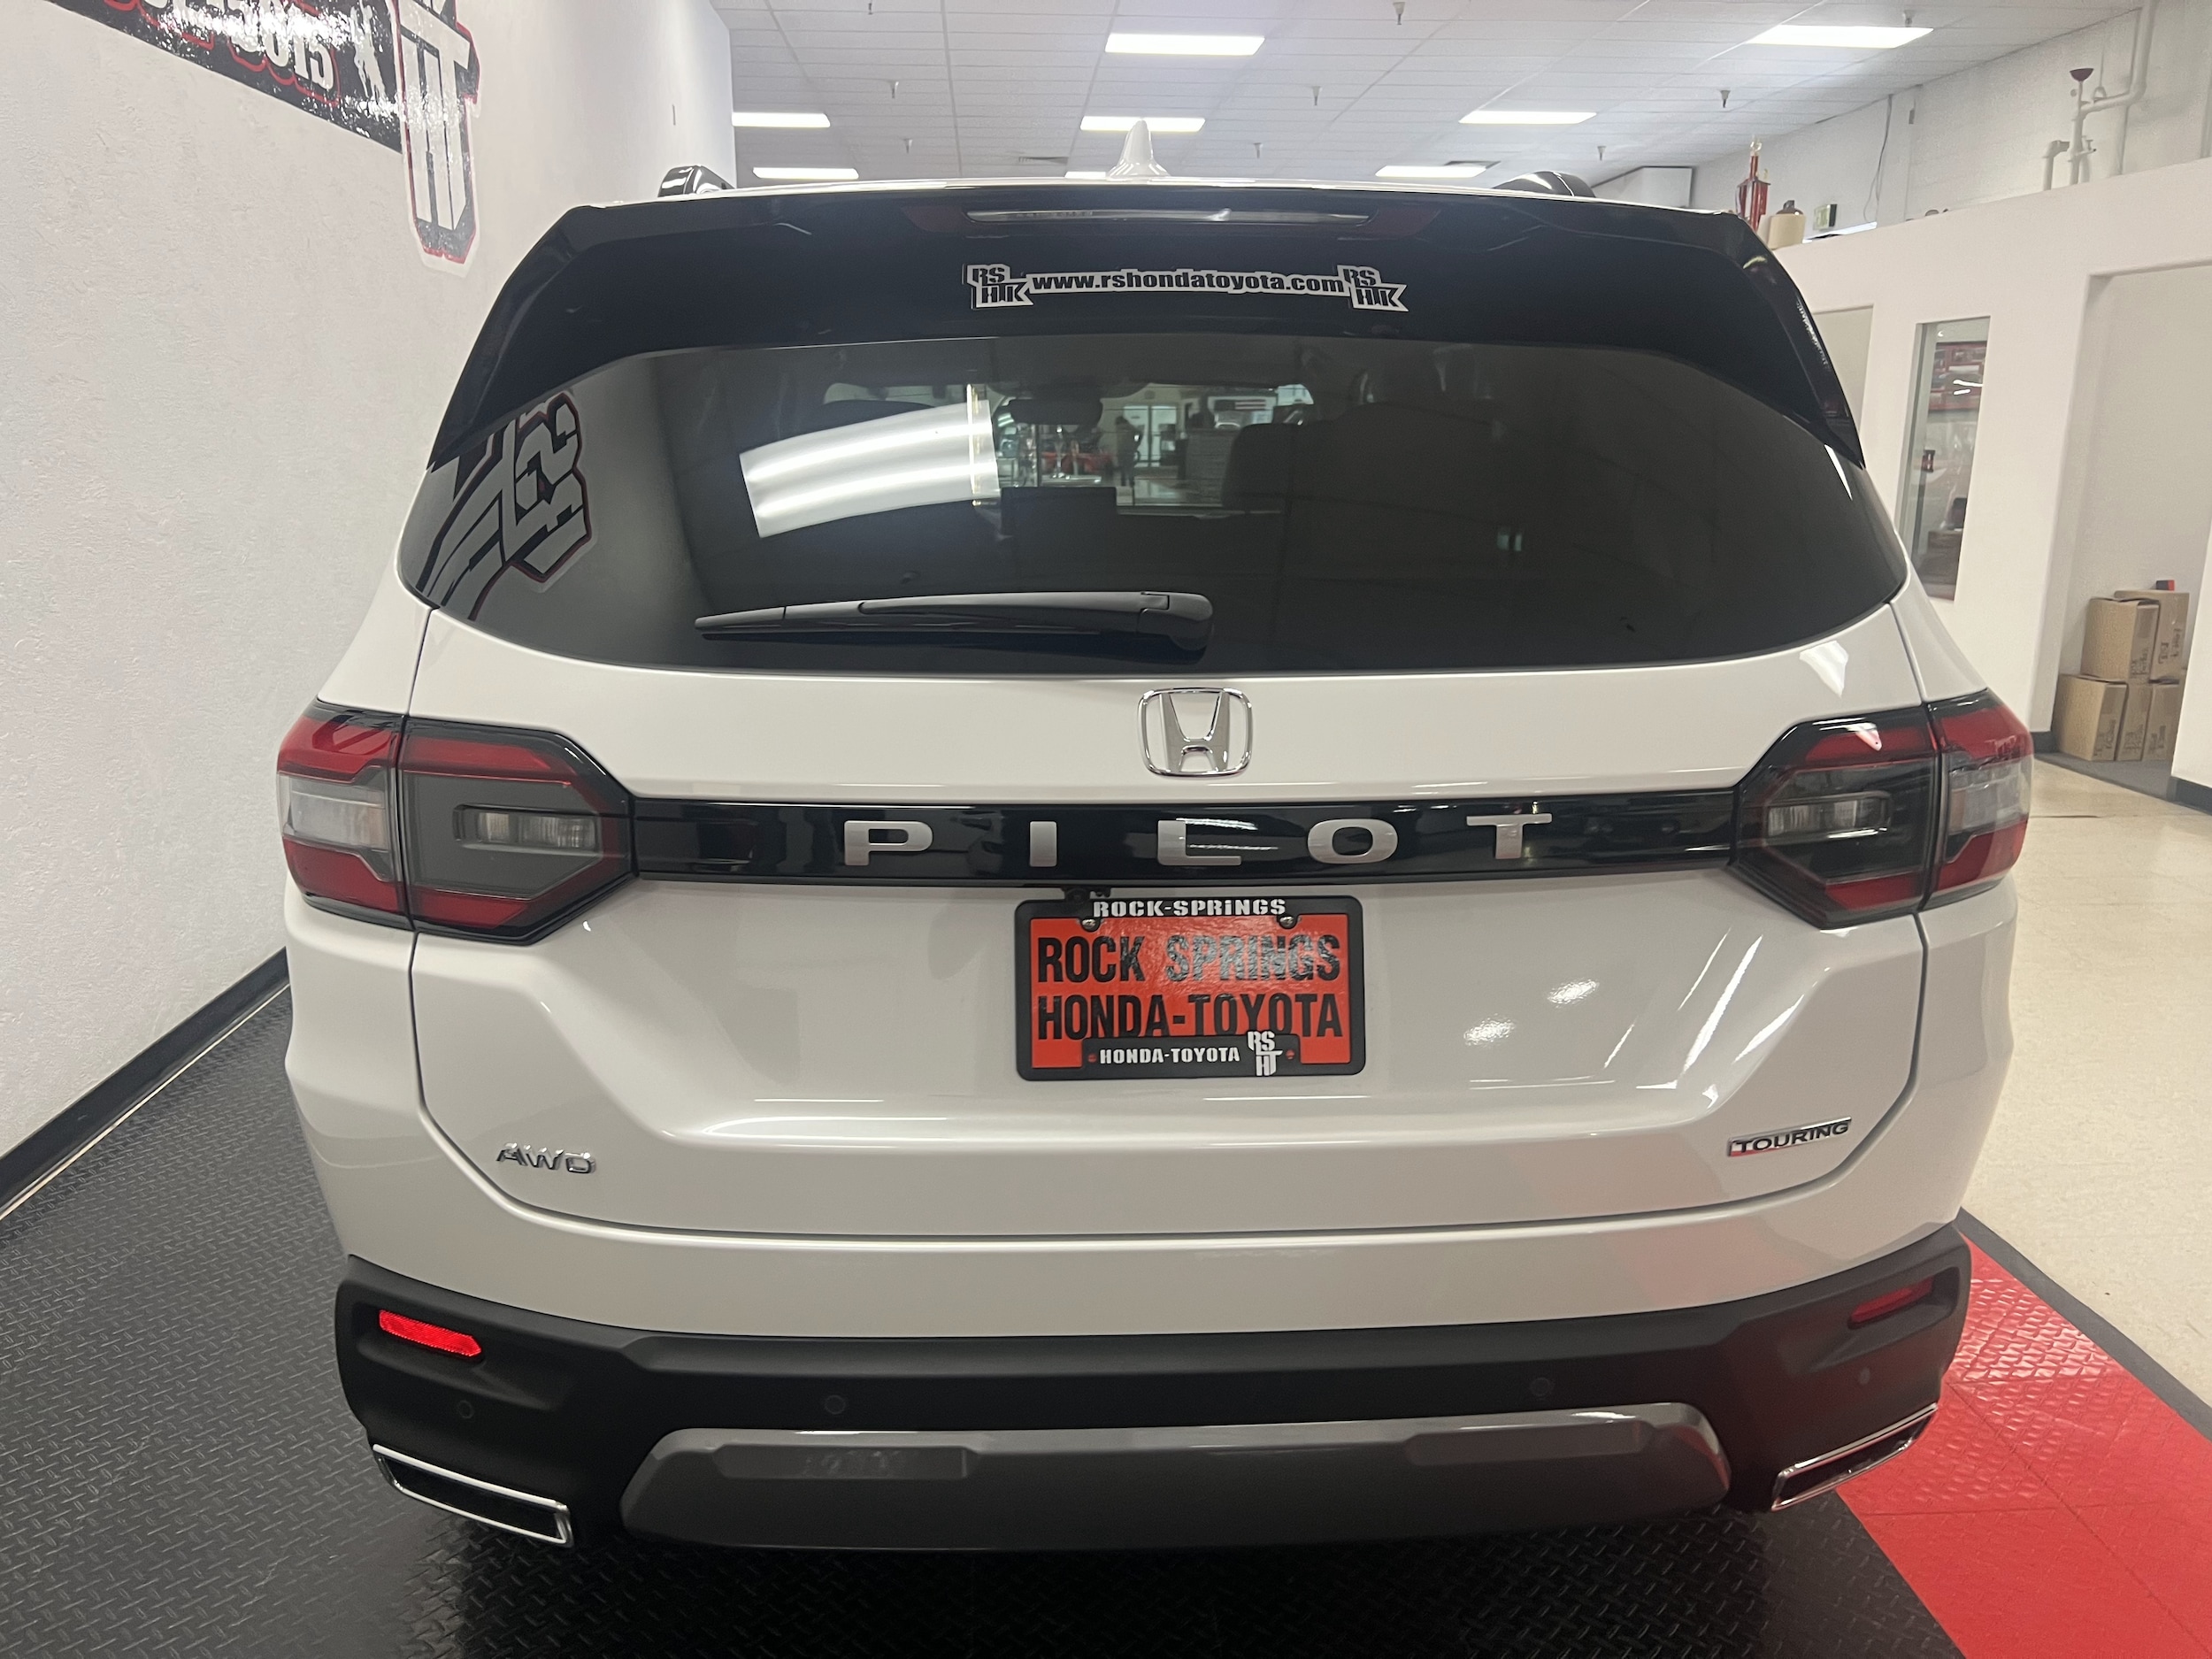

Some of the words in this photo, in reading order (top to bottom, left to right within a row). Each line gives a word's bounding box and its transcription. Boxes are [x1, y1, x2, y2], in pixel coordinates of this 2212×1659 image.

[1033, 272, 1345, 292] www.rshondatoyota.com
[844, 813, 1553, 867] PILOT
[1037, 935, 1146, 982] ROCK
[1164, 934, 1340, 982] SPRINGS
[1038, 992, 1343, 1040] HONDA-TOYOTA
[1100, 1047, 1240, 1064] HONDA-TOYOTA
[1734, 1121, 1850, 1154] TOURING
[495, 1142, 596, 1174] AWD
